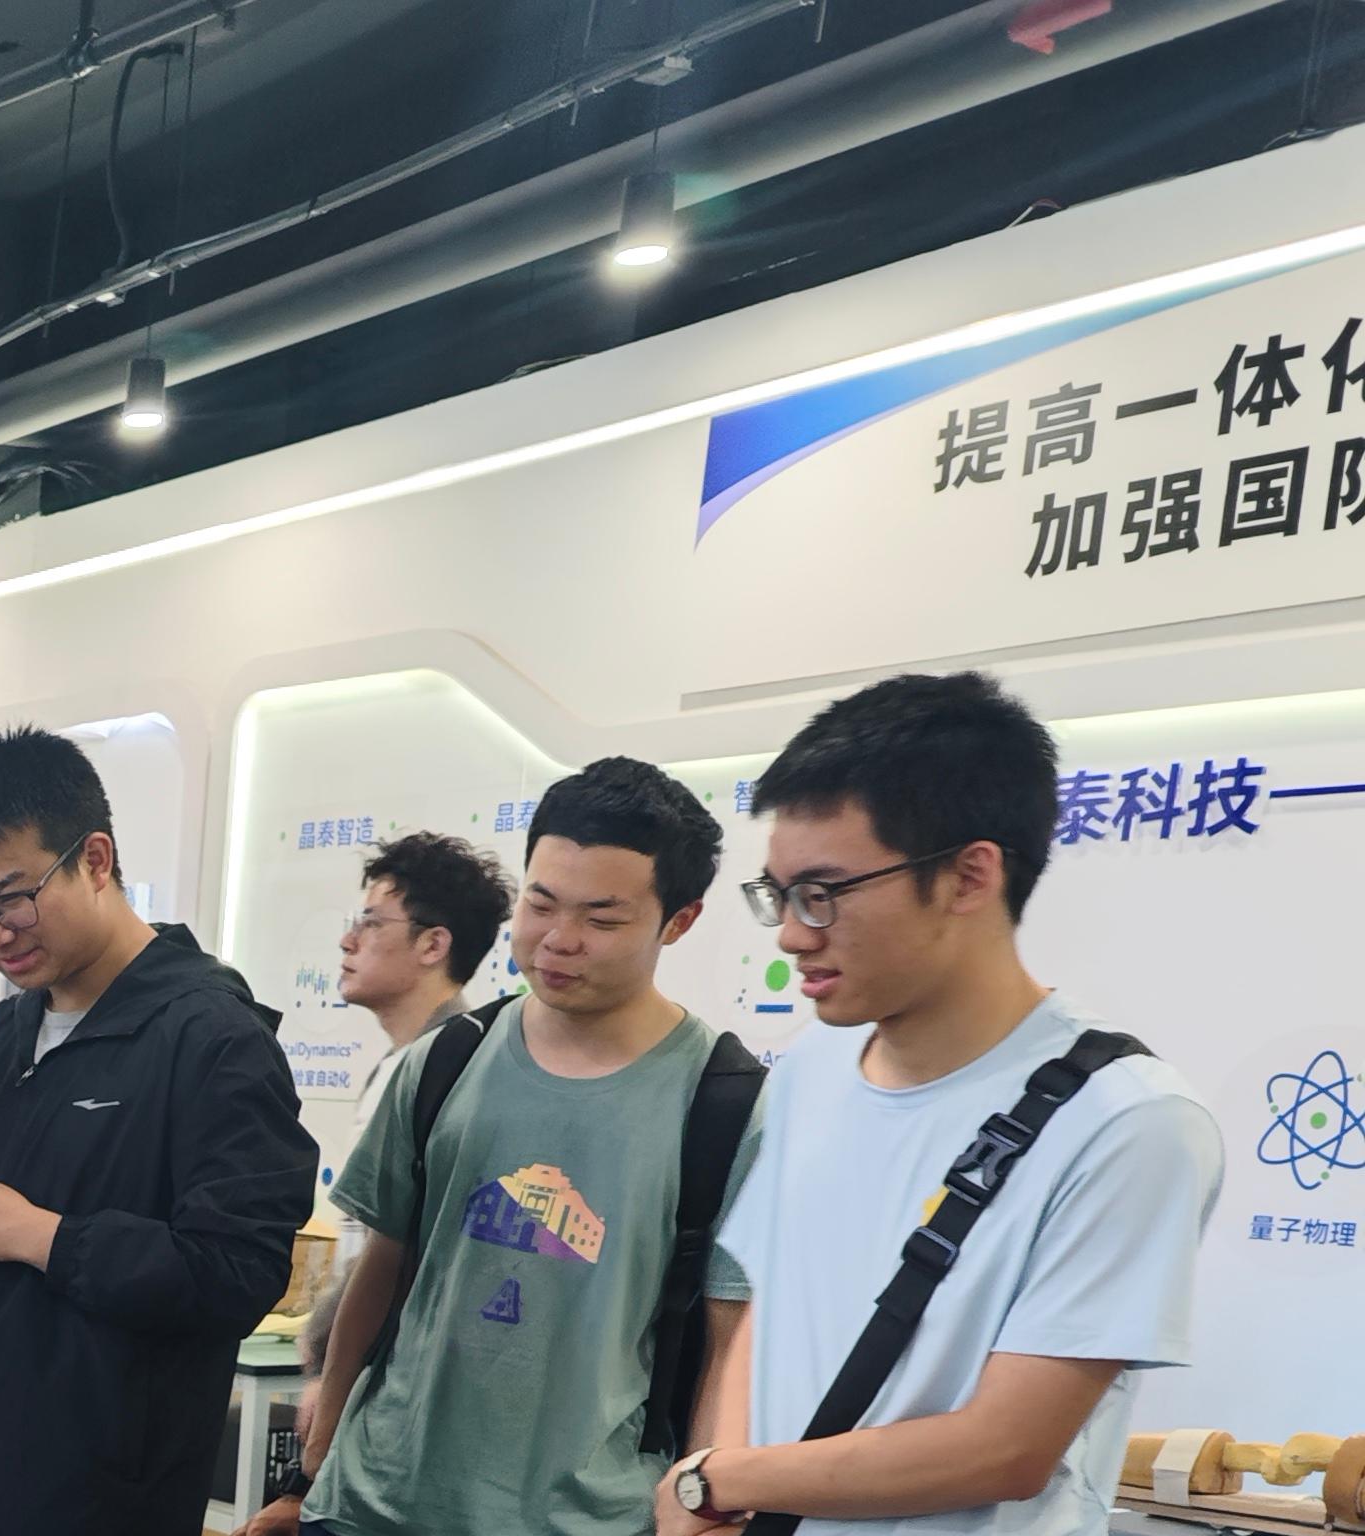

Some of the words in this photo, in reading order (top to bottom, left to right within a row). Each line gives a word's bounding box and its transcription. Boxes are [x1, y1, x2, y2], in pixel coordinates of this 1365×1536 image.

[298, 817, 373, 849] 晶泰智造
[1248, 1215, 1357, 1247] 量子物理
